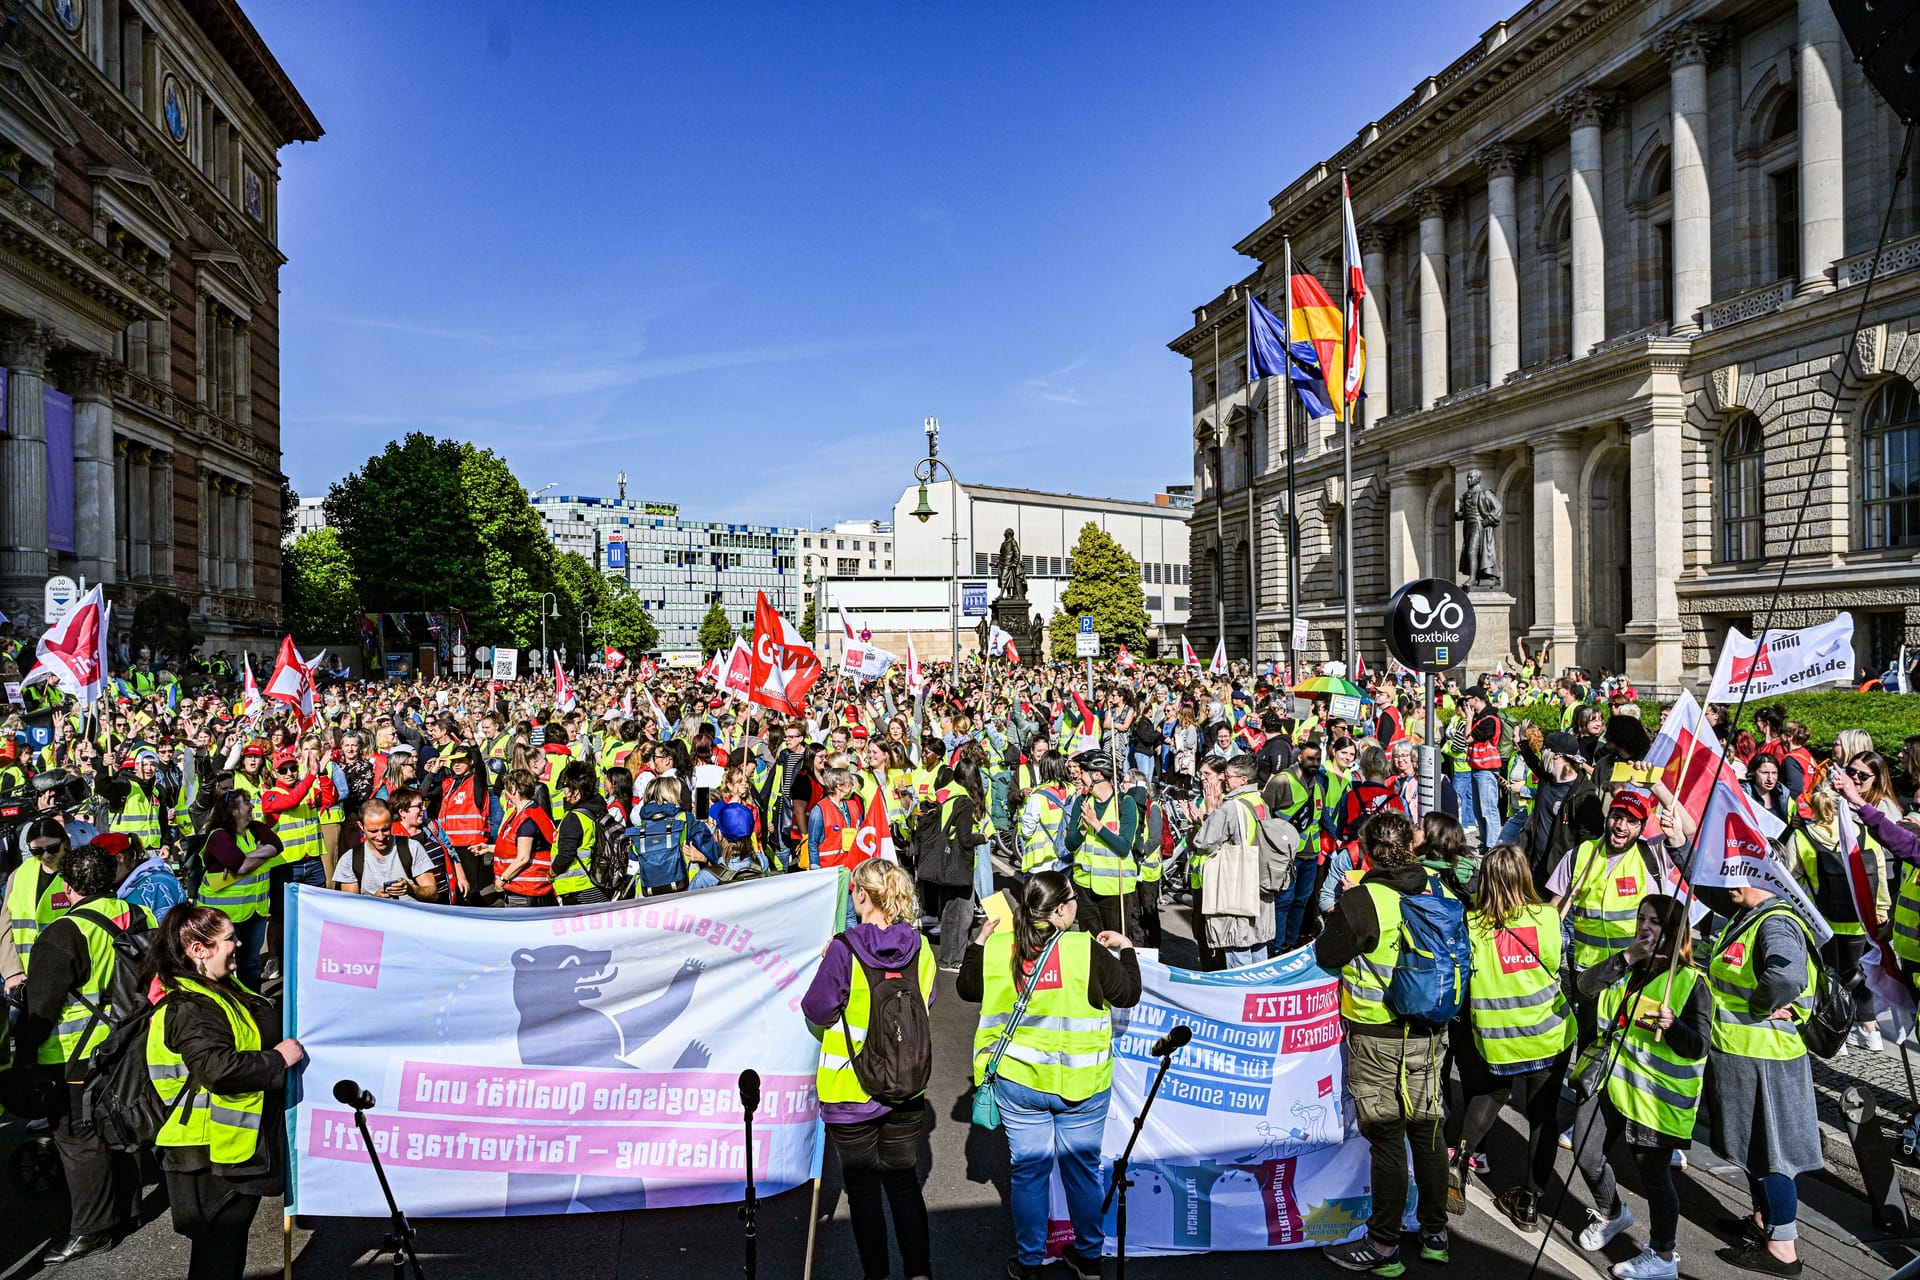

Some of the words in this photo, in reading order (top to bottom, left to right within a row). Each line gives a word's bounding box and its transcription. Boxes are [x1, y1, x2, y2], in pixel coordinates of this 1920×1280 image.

[1410, 630, 1460, 643] nextbike
[1618, 885, 1637, 894] ver.di
[1502, 951, 1537, 965] ver.di
